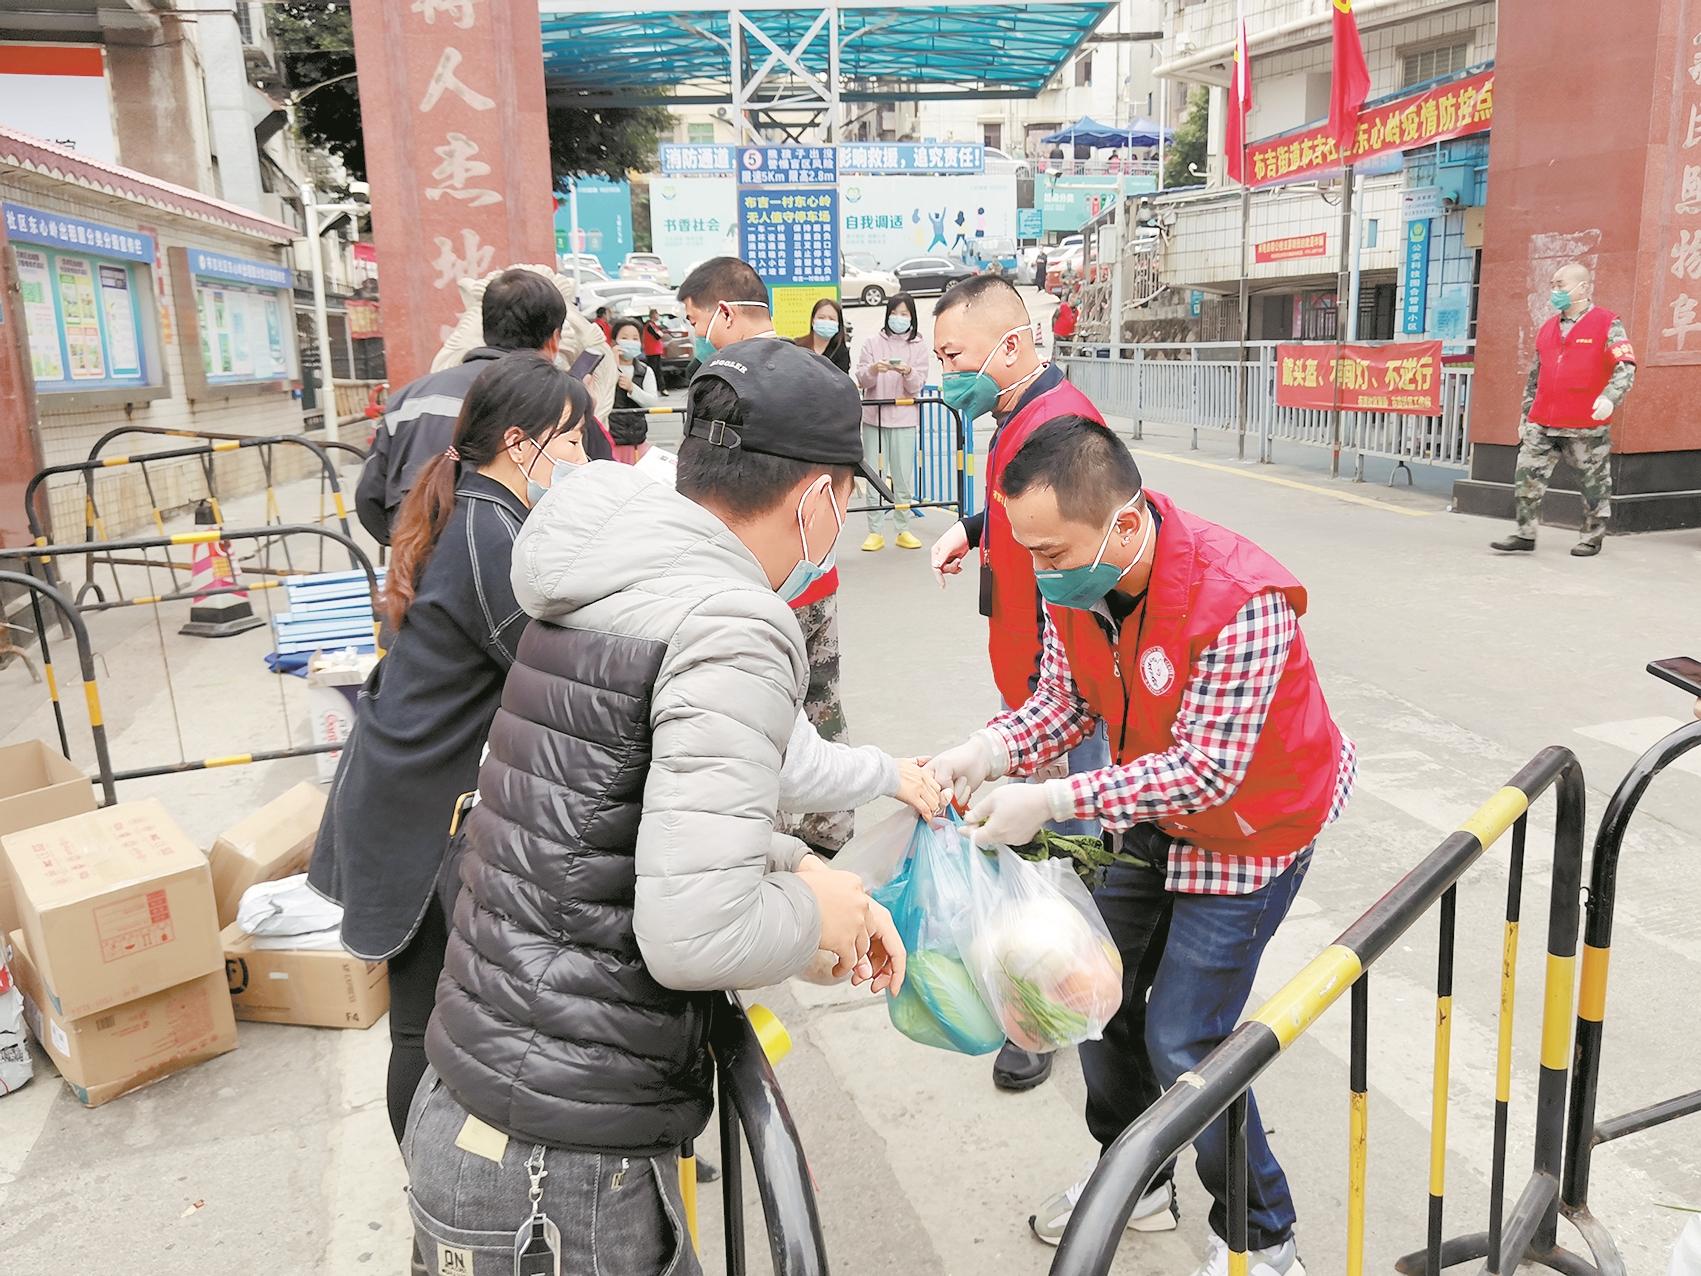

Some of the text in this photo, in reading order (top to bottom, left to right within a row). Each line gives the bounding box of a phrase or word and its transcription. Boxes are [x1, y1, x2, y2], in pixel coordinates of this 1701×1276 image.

[1253, 80, 1494, 181] 布吉街道布吉社东心岭疫情防控点
[747, 152, 757, 166] 5
[410, 0, 504, 345] 人杰地
[744, 194, 832, 208] 布吉一村东心岭
[746, 210, 831, 223] 无人值守停车场
[845, 214, 904, 231] 自我调适
[664, 218, 720, 233] 书香社会
